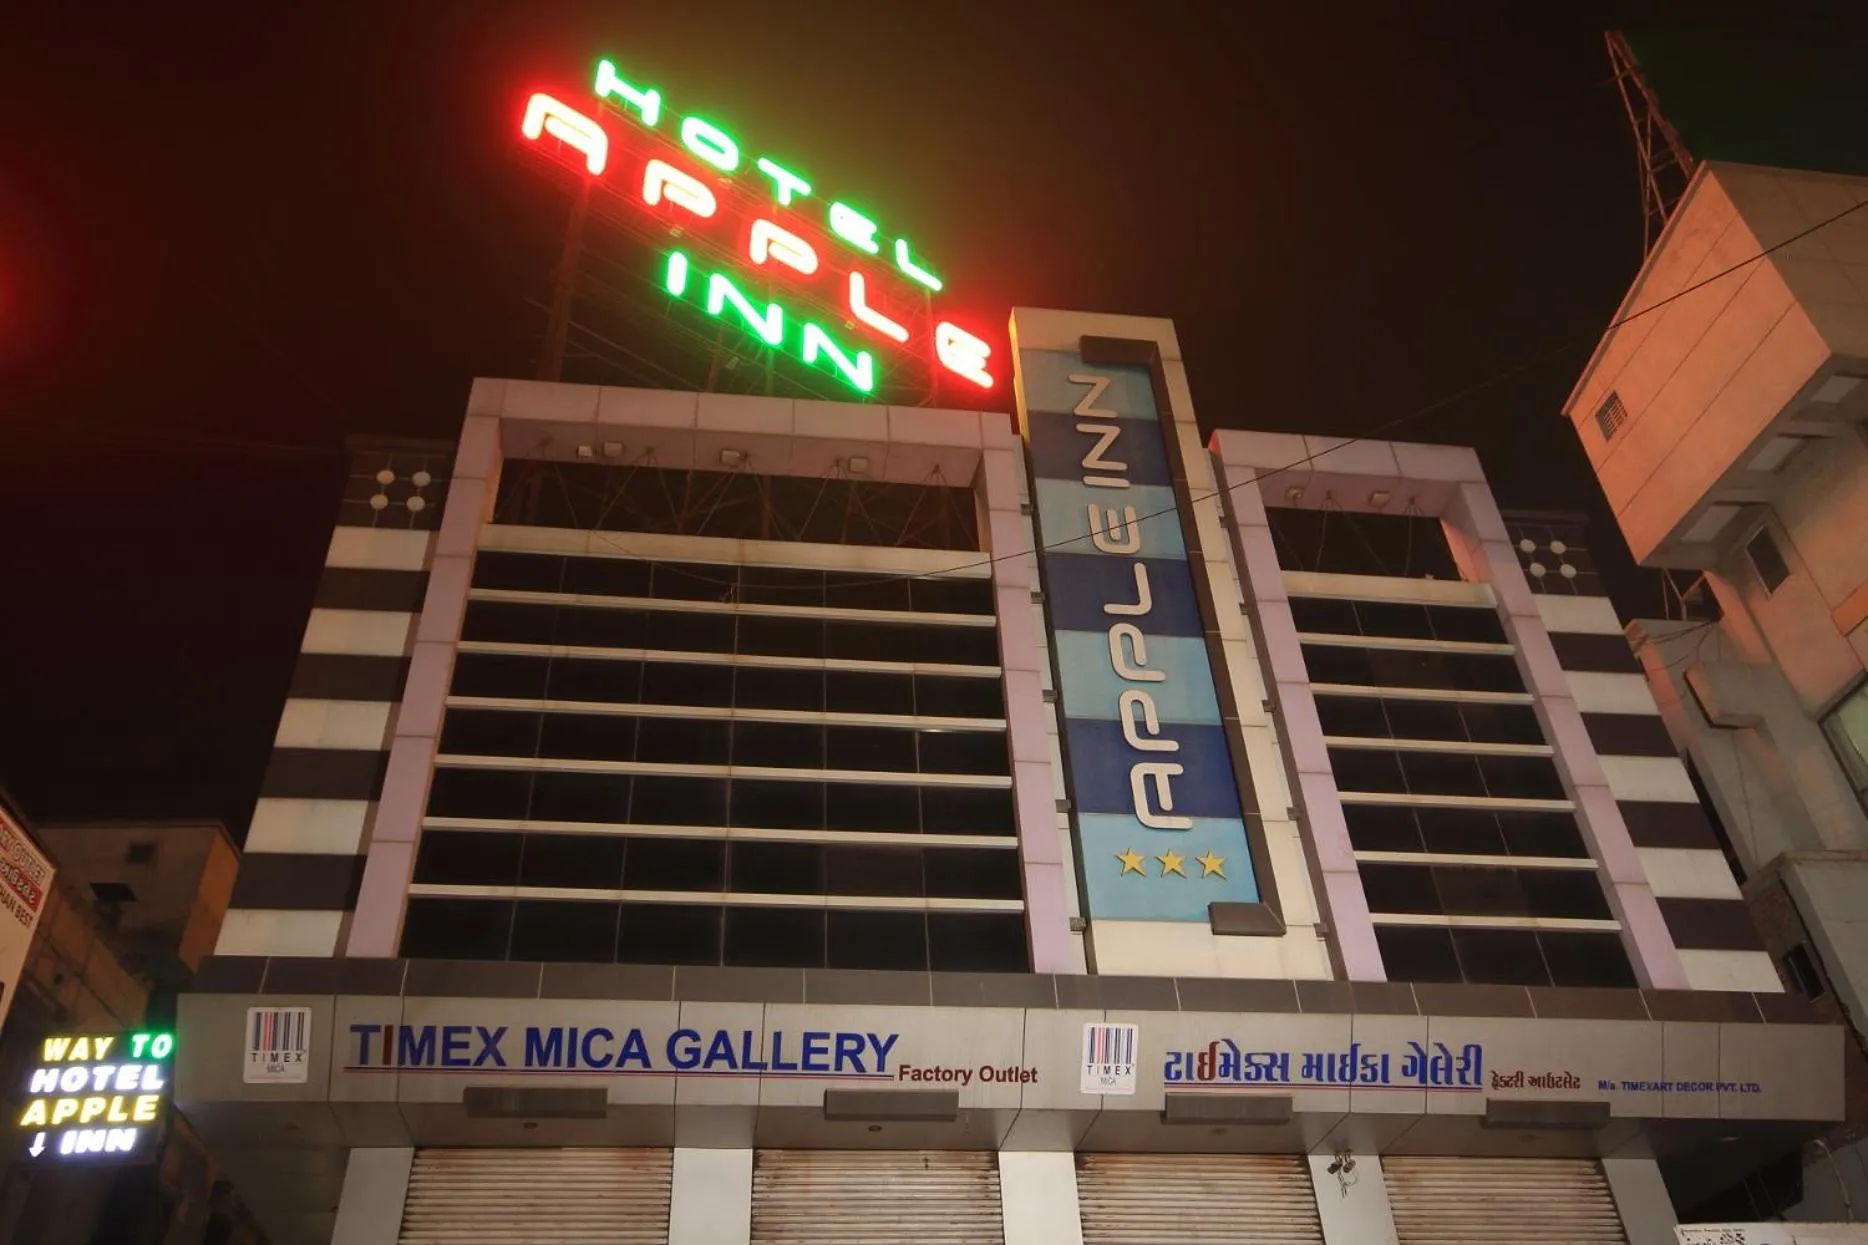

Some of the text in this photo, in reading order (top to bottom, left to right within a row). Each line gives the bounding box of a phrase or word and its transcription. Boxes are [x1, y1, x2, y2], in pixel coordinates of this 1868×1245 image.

[595, 58, 943, 291] HOTEL
[521, 92, 994, 389] APPLE
[667, 251, 873, 392] INN
[1066, 373, 1193, 831] APPLE INN
[43, 1034, 173, 1062] WAY TO
[251, 1052, 303, 1063] TIMEX
[350, 1024, 899, 1073] TIMEX MICA GALLERY
[1164, 1038, 1483, 1085] ટાઈમેક્સ માઈકા ગેલેરી
[30, 1065, 164, 1093] HOTEL
[898, 1065, 1038, 1086] Factory Outlet
[1087, 1065, 1132, 1076] TIMEX
[1621, 1081, 1673, 1092] TIMEXART
[1675, 1082, 1713, 1093] DECOR
[1715, 1083, 1737, 1093] PVT.
[1739, 1083, 1761, 1094] LTD.
[20, 1095, 160, 1127] APPLE
[60, 1128, 138, 1155] INN
